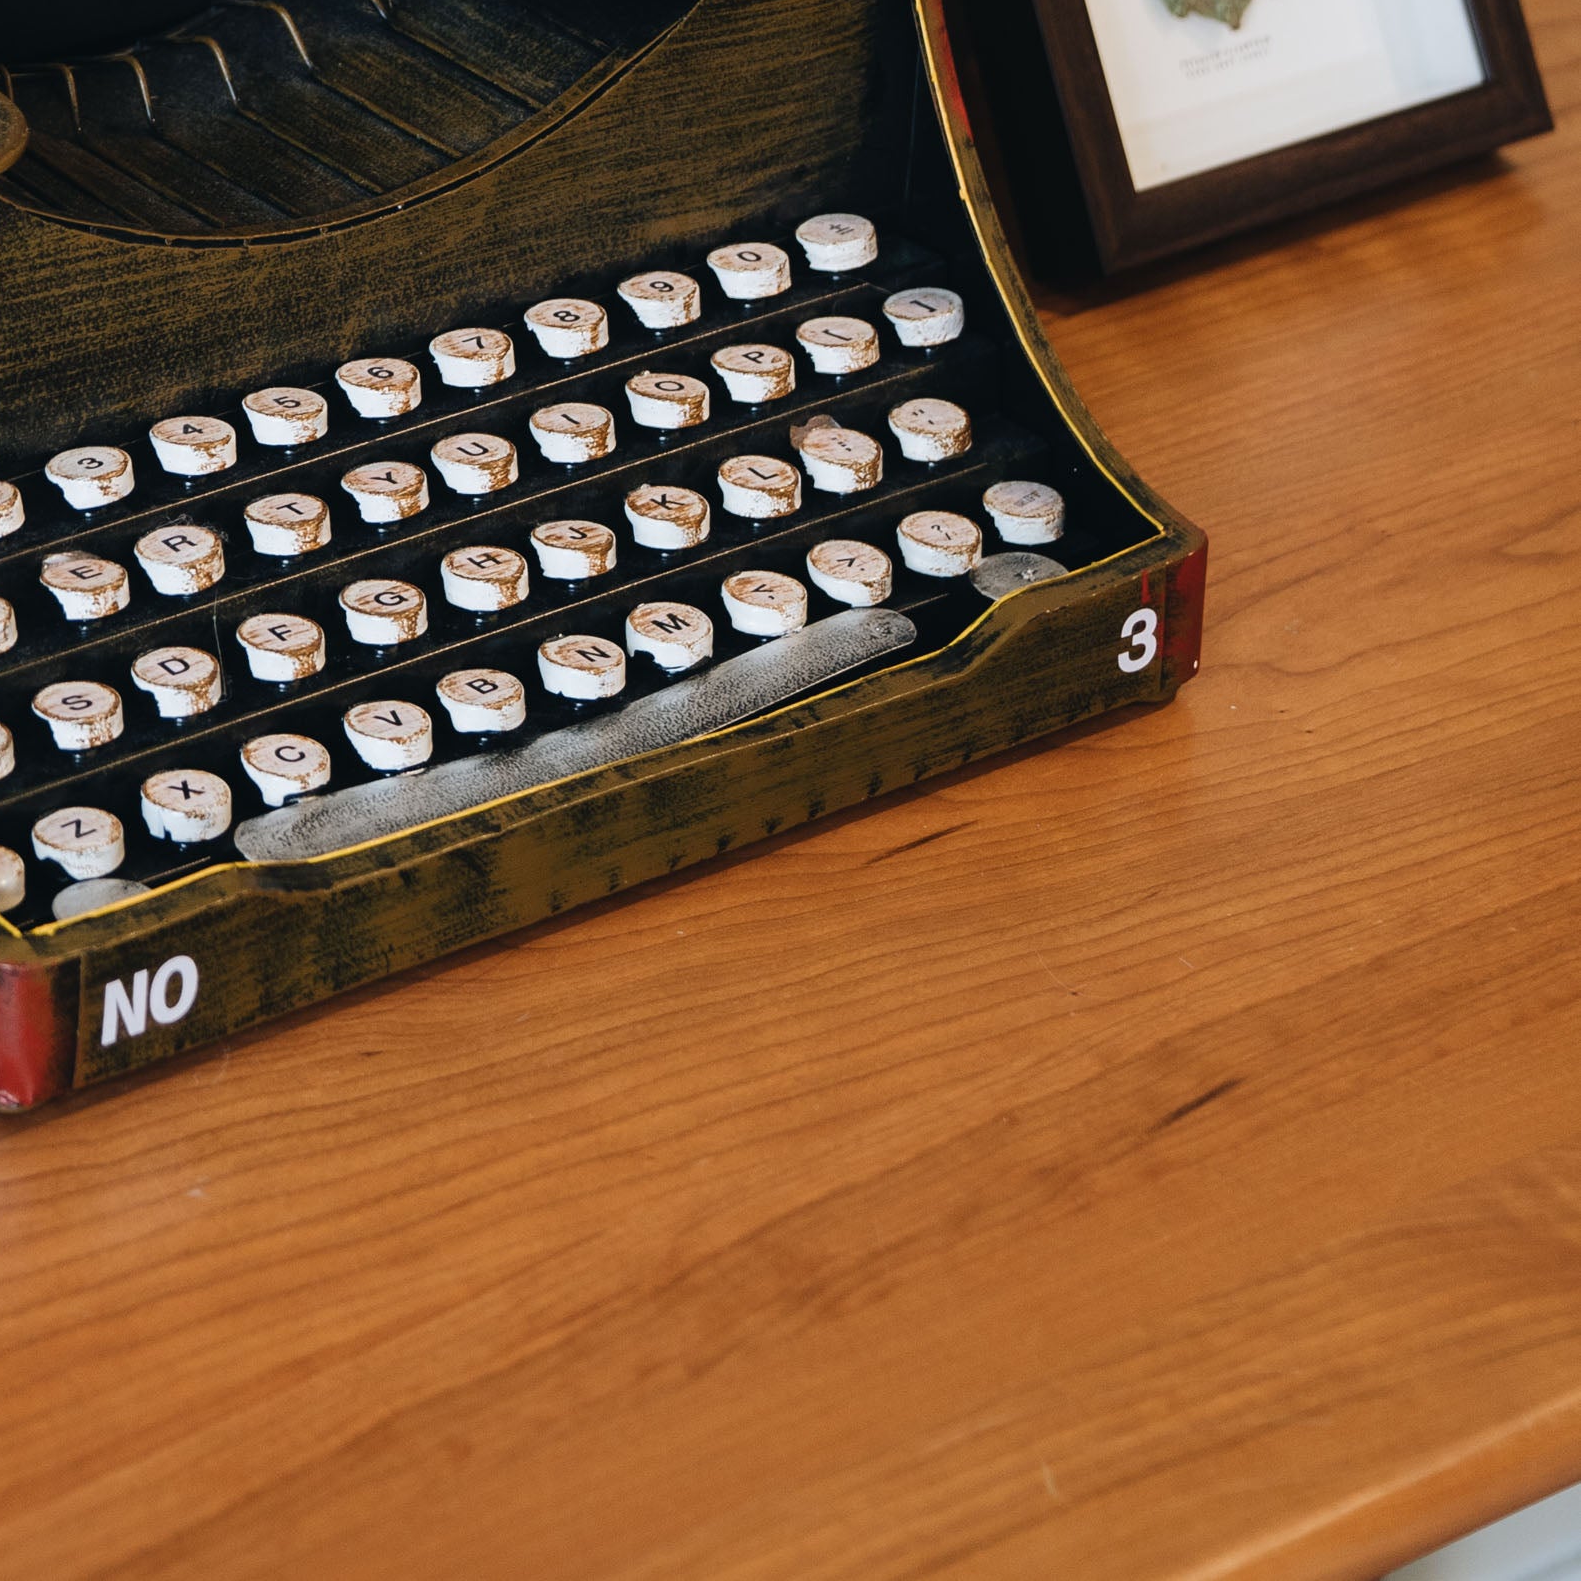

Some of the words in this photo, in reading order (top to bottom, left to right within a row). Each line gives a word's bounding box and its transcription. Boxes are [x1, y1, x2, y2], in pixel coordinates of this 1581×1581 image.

[69, 565, 102, 580] E
[162, 535, 197, 553] R
[276, 502, 304, 516] T
[370, 471, 397, 485] Y
[457, 442, 489, 456] U
[742, 351, 765, 364] P
[77, 457, 103, 470] 3
[182, 423, 203, 435] 4
[273, 396, 300, 409] 5
[367, 366, 394, 379] 6
[462, 336, 485, 349] 7
[553, 310, 580, 322] 8
[649, 280, 674, 292] 9
[61, 695, 93, 710] S
[157, 657, 190, 676] D
[267, 623, 292, 642] F
[374, 591, 409, 606] G
[468, 551, 501, 569] H
[569, 526, 587, 540] J
[650, 493, 685, 511] K
[747, 466, 778, 480] L
[1118, 607, 1158, 673] 3
[60, 818, 97, 839] Z
[169, 779, 204, 800] X
[275, 746, 306, 762] C
[374, 709, 403, 727] V
[465, 677, 500, 695] B
[575, 645, 611, 662] N
[651, 612, 690, 634] M
[101, 954, 199, 1047] NO
